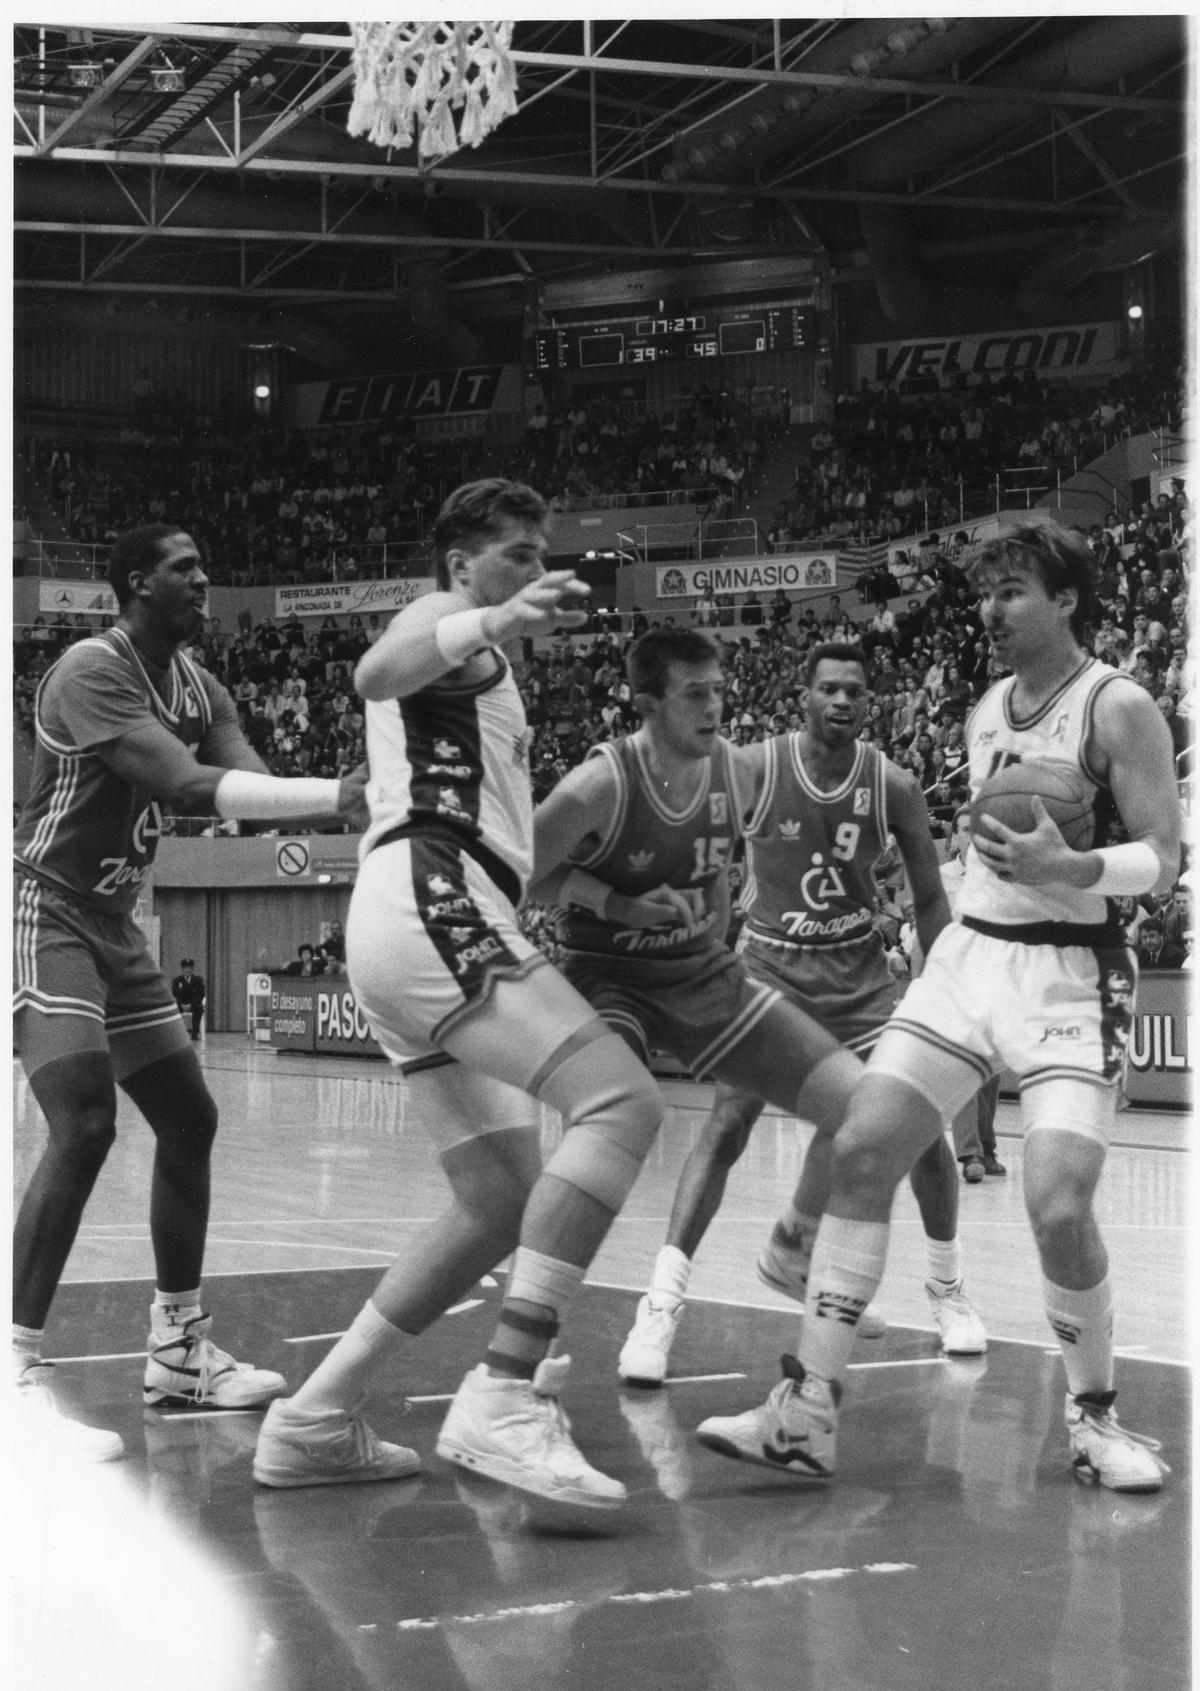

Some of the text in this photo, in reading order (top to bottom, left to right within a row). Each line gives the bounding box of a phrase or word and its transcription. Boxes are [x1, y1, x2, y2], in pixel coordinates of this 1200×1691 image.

[652, 317, 697, 334] 17:27
[634, 348, 655, 362] 39
[694, 342, 716, 356] 45
[332, 374, 490, 415] FIAT
[693, 564, 799, 590] GIMNASIO
[280, 586, 352, 599] RESTAURANTE
[334, 600, 343, 609] DE
[832, 822, 861, 861] 9
[687, 837, 730, 881] 15
[274, 1015, 306, 1038] completo
[318, 992, 378, 1040] PASC
